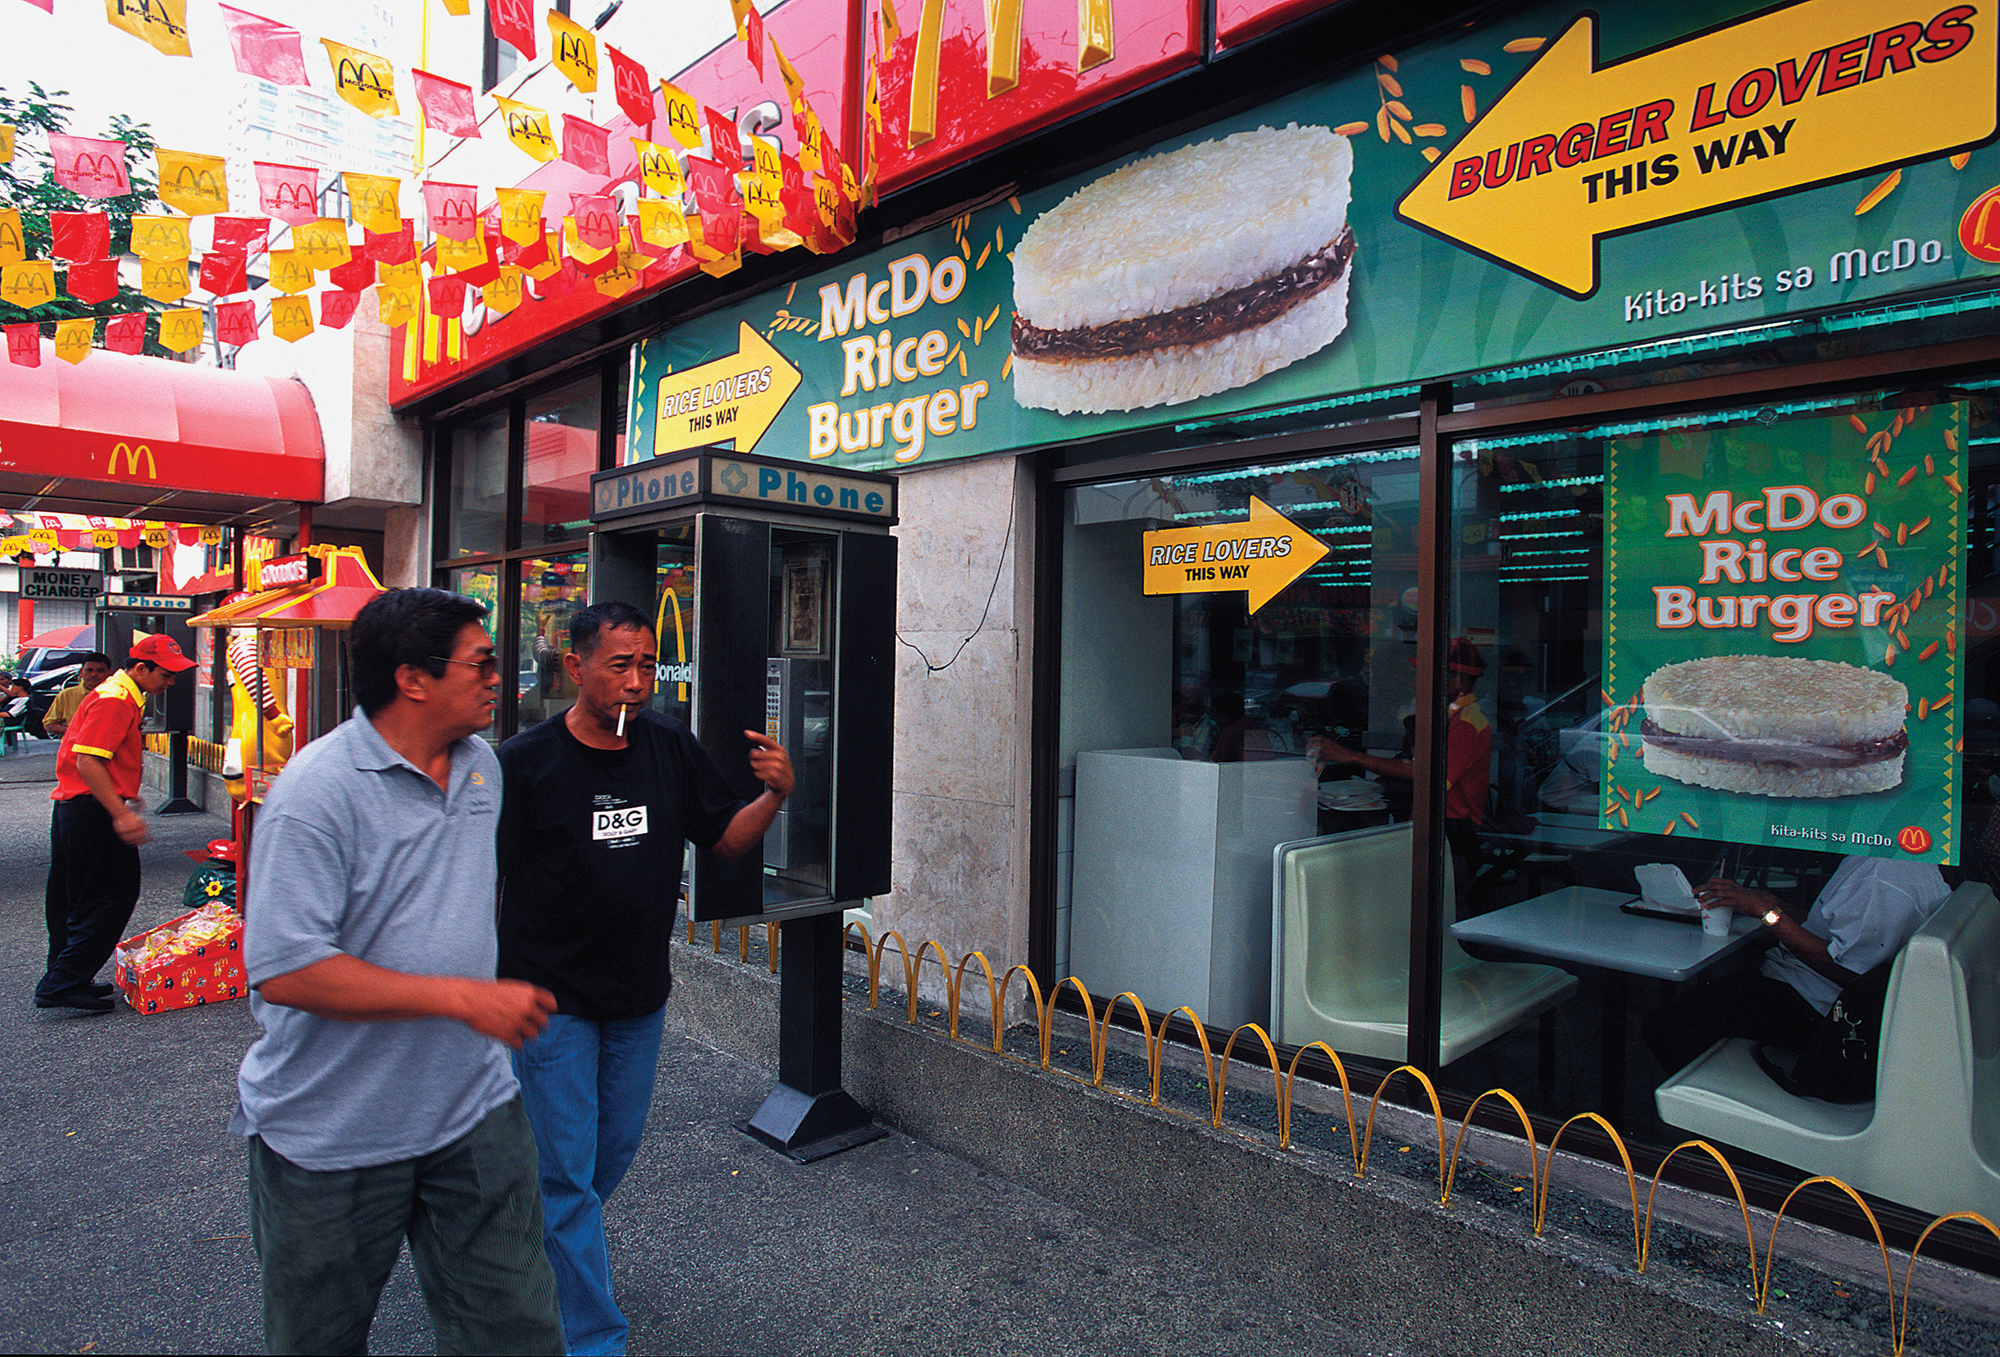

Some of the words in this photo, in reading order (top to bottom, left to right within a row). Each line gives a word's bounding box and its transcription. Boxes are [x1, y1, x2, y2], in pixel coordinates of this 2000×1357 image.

[1447, 98, 1675, 201] BURGER
[1689, 4, 1979, 133] LOVERS
[1582, 153, 1680, 204] THIS
[1693, 118, 1797, 174] WAY
[818, 253, 967, 341] McDo
[1624, 275, 1764, 322] Kita-kits
[1776, 265, 1814, 294] sa
[1829, 238, 1942, 284] McDo
[841, 329, 948, 397] Rice
[662, 388, 698, 419] RICE
[702, 366, 772, 409] LOVERS
[688, 413, 712, 433] THIS
[715, 406, 740, 427] WAY
[807, 380, 989, 463] Burger
[616, 470, 695, 508] Phone
[758, 467, 885, 513] Phone
[1664, 485, 1867, 538] McDo
[1150, 543, 1198, 567] RICE
[1202, 536, 1293, 562] LOVERS
[1185, 567, 1216, 582] THIS
[1219, 564, 1250, 581] WAY
[1698, 538, 1843, 584] Rice
[33, 572, 92, 585] MONEY
[127, 594, 187, 608] Phone
[1652, 585, 1897, 643] Burger
[598, 810, 643, 831] D&G
[1771, 823, 1828, 841] Kita-kits
[1831, 829, 1847, 843] sa
[1851, 831, 1892, 848] McDo
